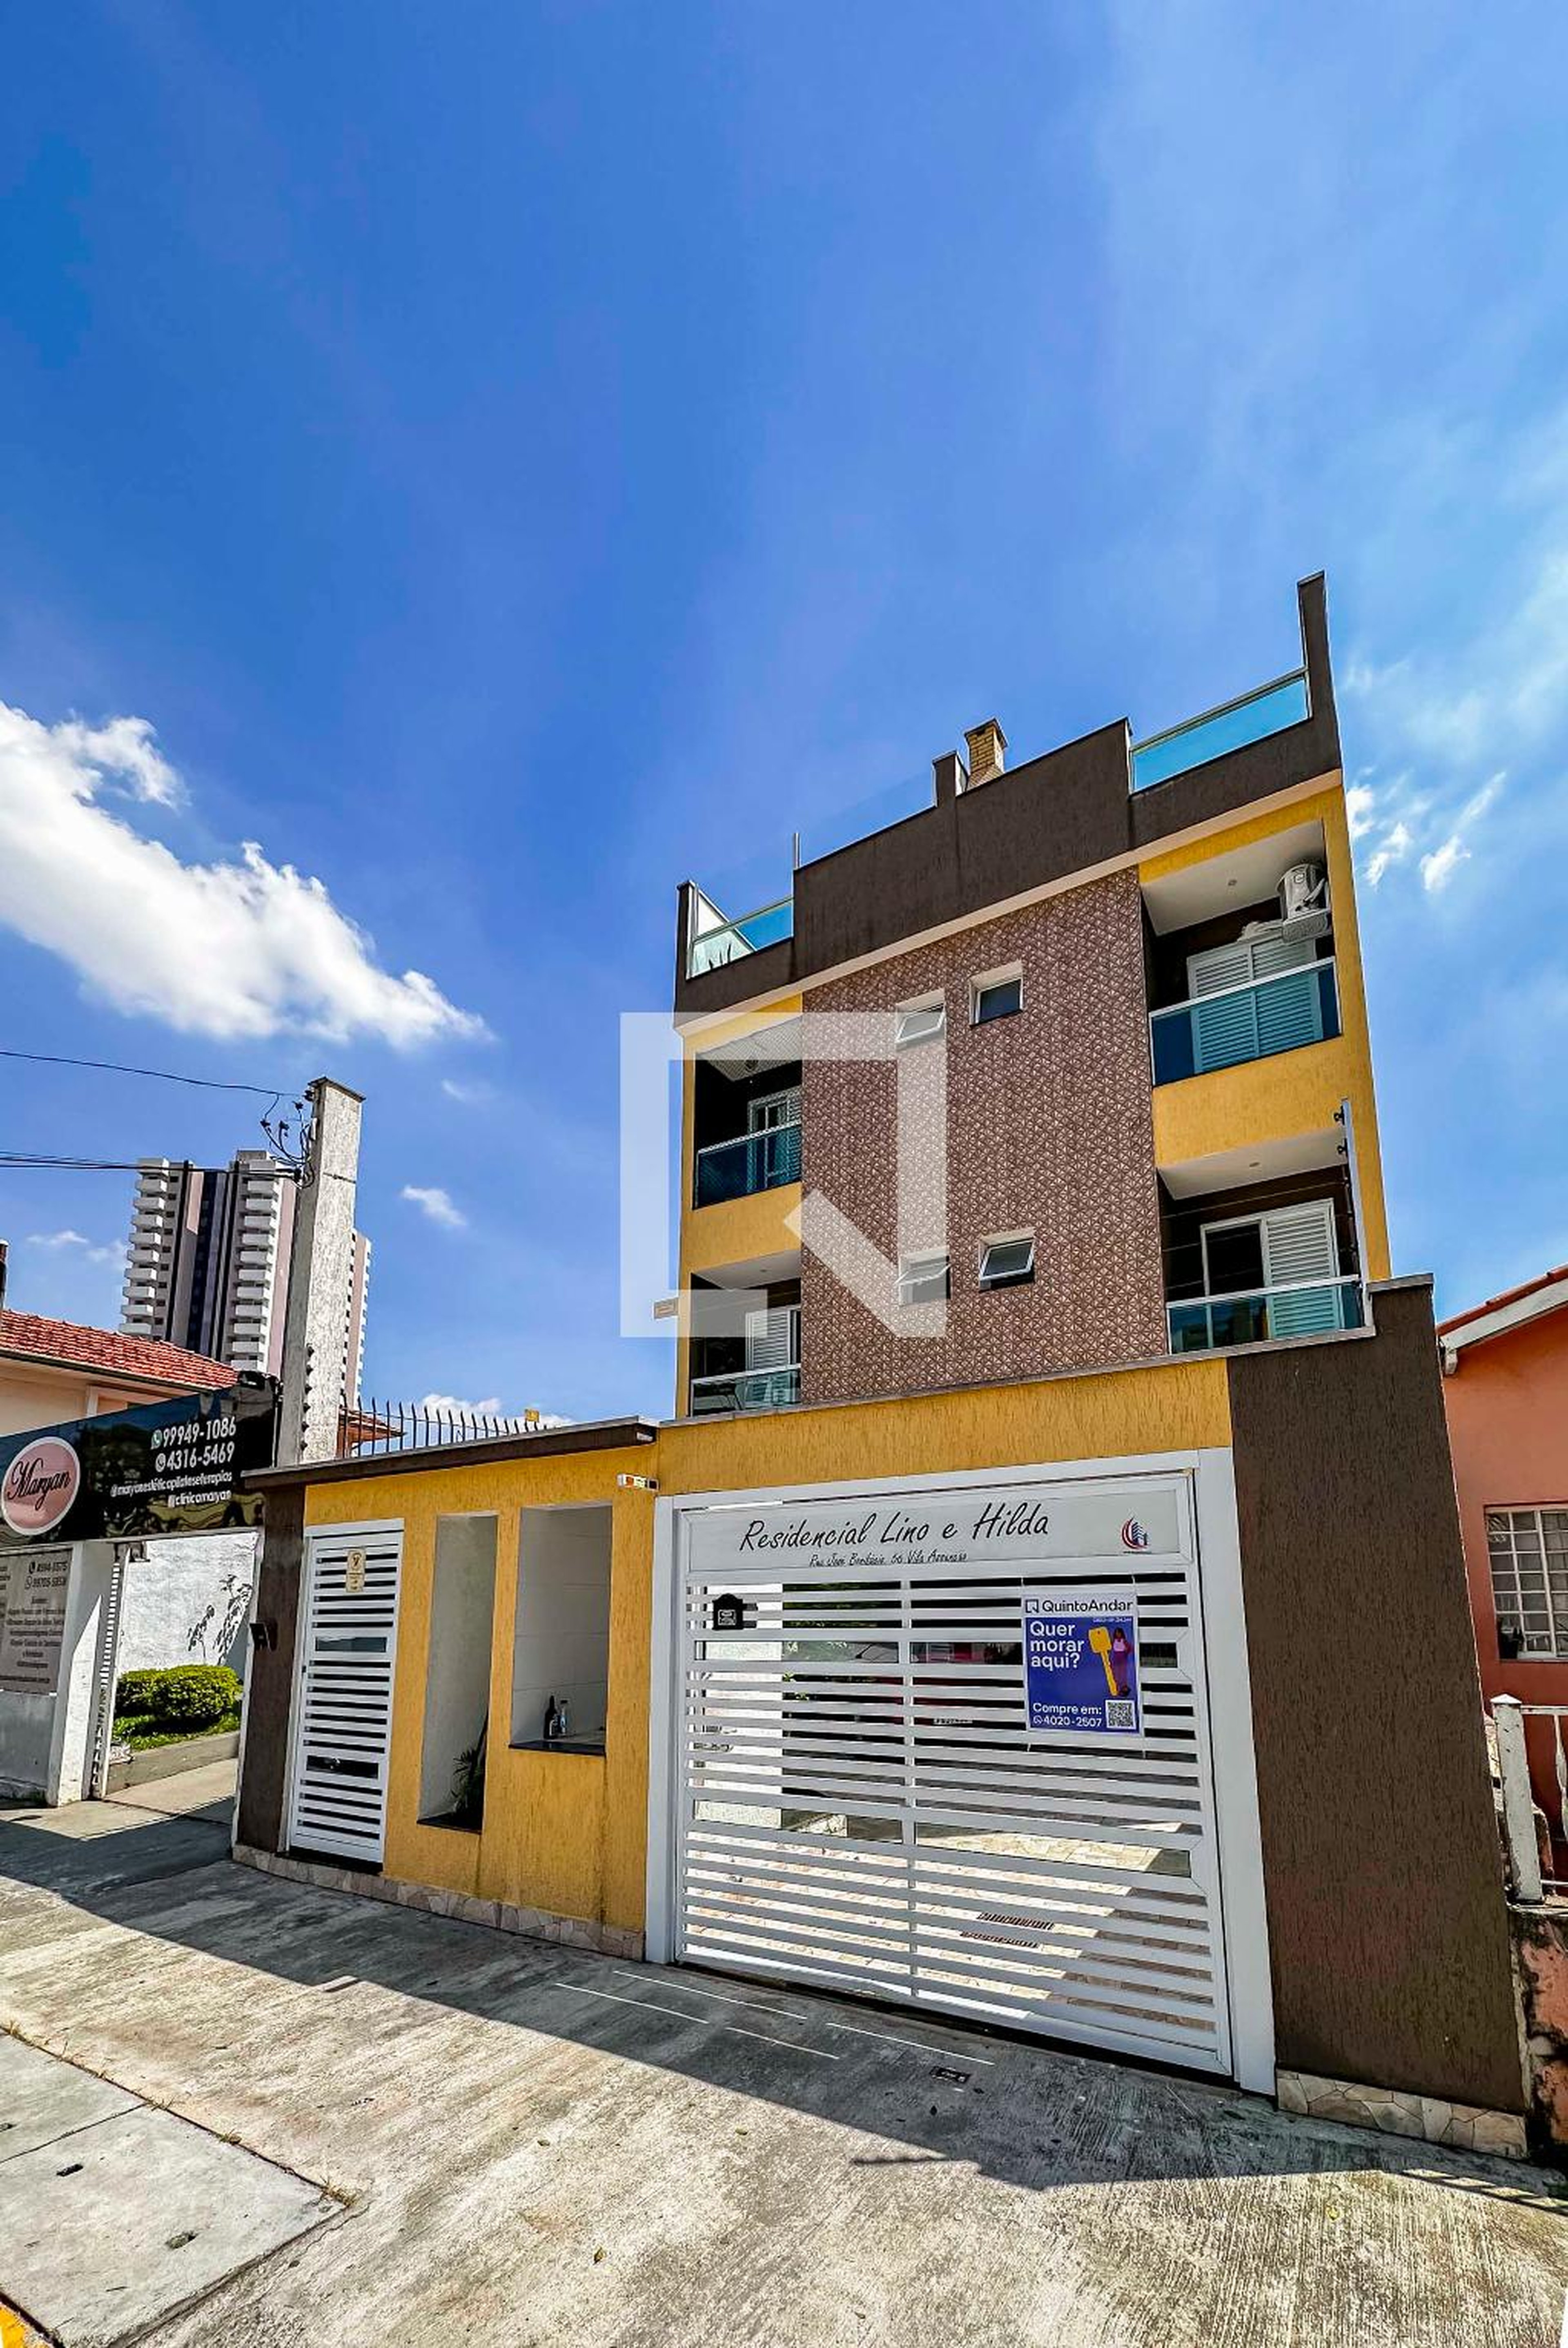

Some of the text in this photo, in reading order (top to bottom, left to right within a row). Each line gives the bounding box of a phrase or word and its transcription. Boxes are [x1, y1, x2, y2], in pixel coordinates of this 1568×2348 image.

[163, 1416, 236, 1447] 99949-1086
[167, 1441, 235, 1470] 4316-5469
[7, 1458, 71, 1510] Maryan
[739, 1503, 1048, 1551] Residencial Lino e Hilda
[1042, 1599, 1133, 1612] QuintoAndar
[1030, 1621, 1075, 1636] Quer
[1030, 1640, 1085, 1652] morar
[1031, 1652, 1080, 1671] aqui?
[1033, 1702, 1102, 1715] Compre em:
